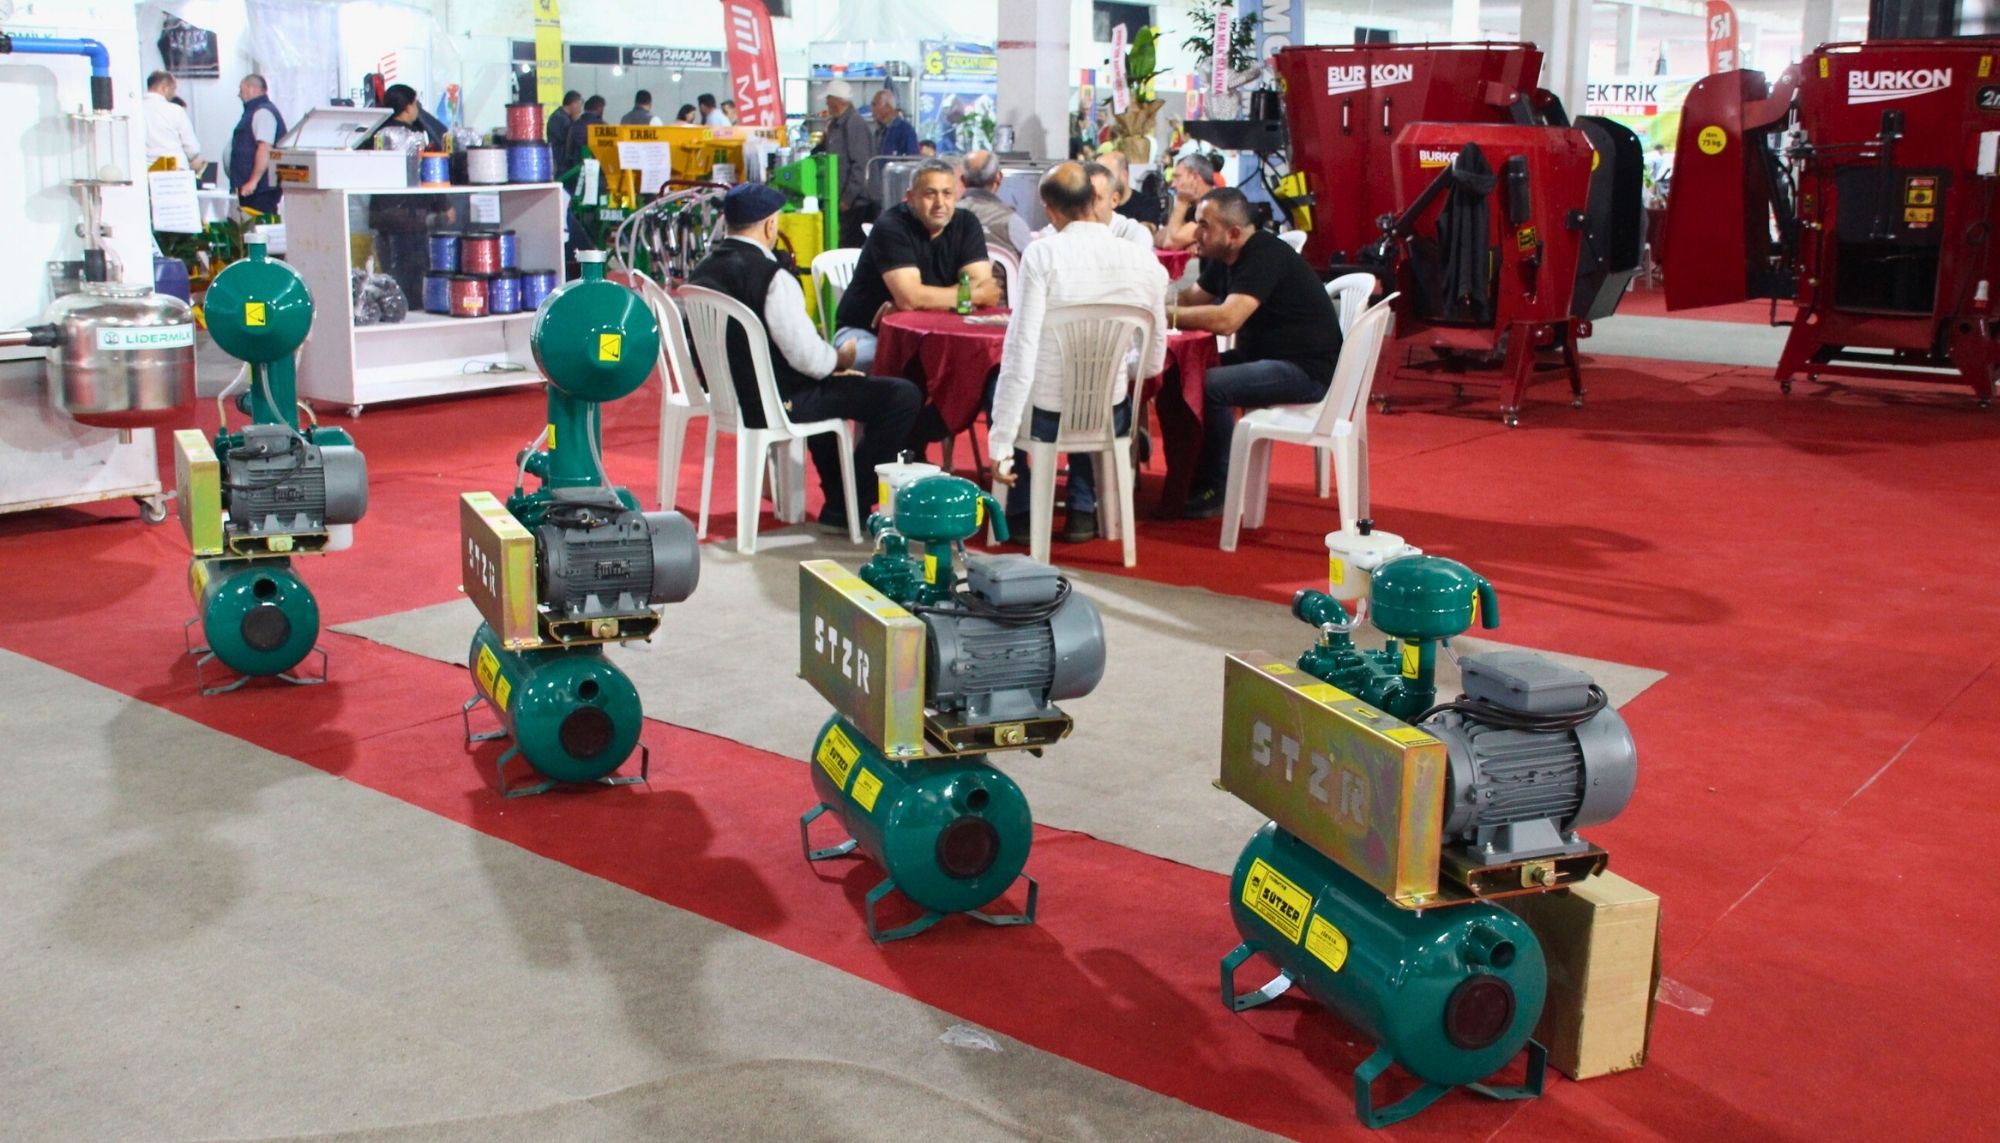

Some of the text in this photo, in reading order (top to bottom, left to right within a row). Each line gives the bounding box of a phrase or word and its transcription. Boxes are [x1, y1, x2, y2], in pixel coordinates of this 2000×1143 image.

[1327, 64, 1413, 82] BURKON
[1848, 68, 1953, 90] BURKON
[814, 614, 870, 695] STZR
[1252, 718, 1365, 827] STZR
